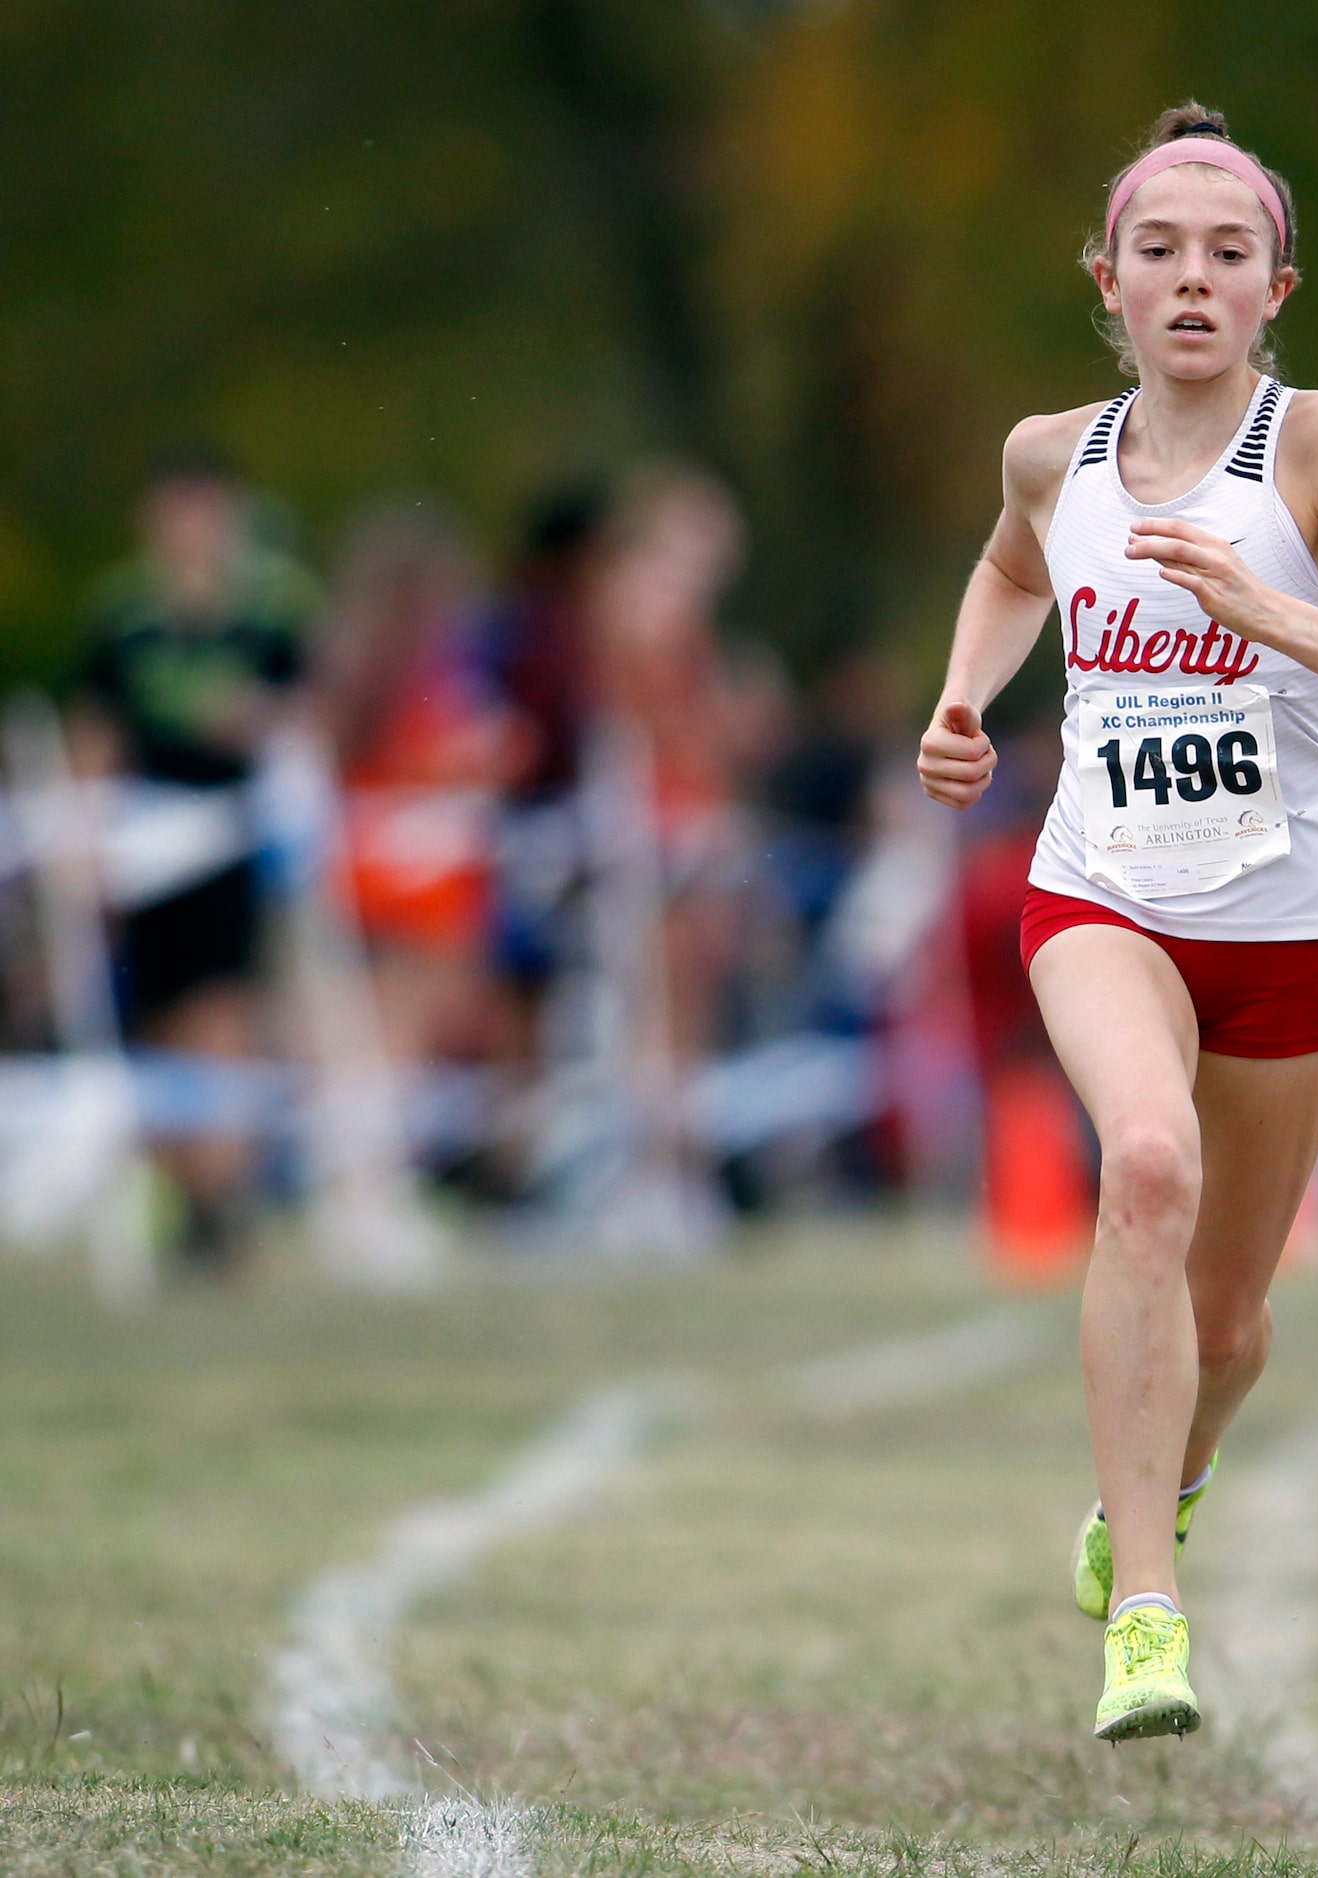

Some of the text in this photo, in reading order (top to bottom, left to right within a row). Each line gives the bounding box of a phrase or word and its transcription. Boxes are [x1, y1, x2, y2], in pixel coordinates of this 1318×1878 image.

[1068, 586, 1259, 686] Liberty
[1116, 692, 1222, 709] UIL Region II
[1101, 711, 1246, 729] XC Championship
[1097, 730, 1262, 808] 1496
[1137, 816, 1228, 833] The University of Texas
[1145, 827, 1222, 845] ARLINGTON
